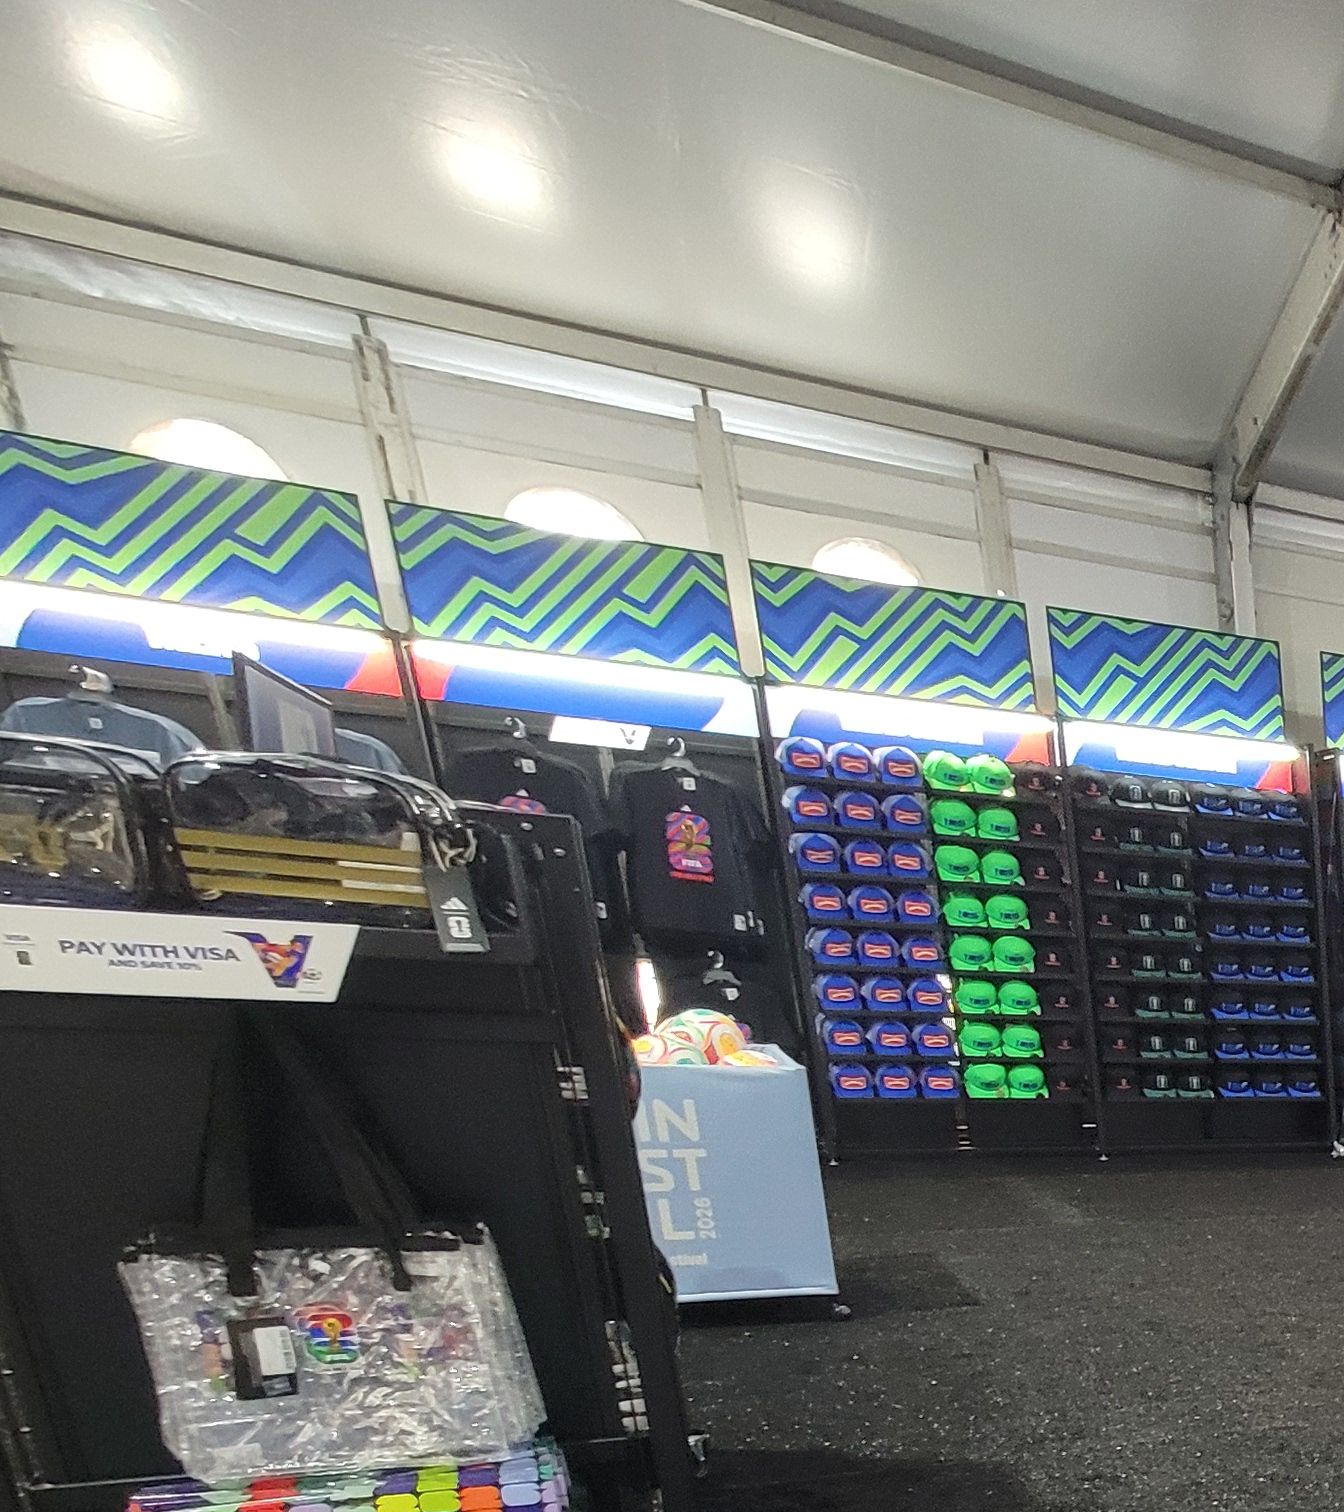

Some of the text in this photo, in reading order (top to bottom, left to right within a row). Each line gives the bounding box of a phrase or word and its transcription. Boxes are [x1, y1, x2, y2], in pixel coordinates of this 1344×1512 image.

[59, 940, 241, 963] PAY WITH VISA
[108, 959, 140, 969] AND
[141, 961, 176, 971] SAVE
[693, 1197, 717, 1241] 2026
